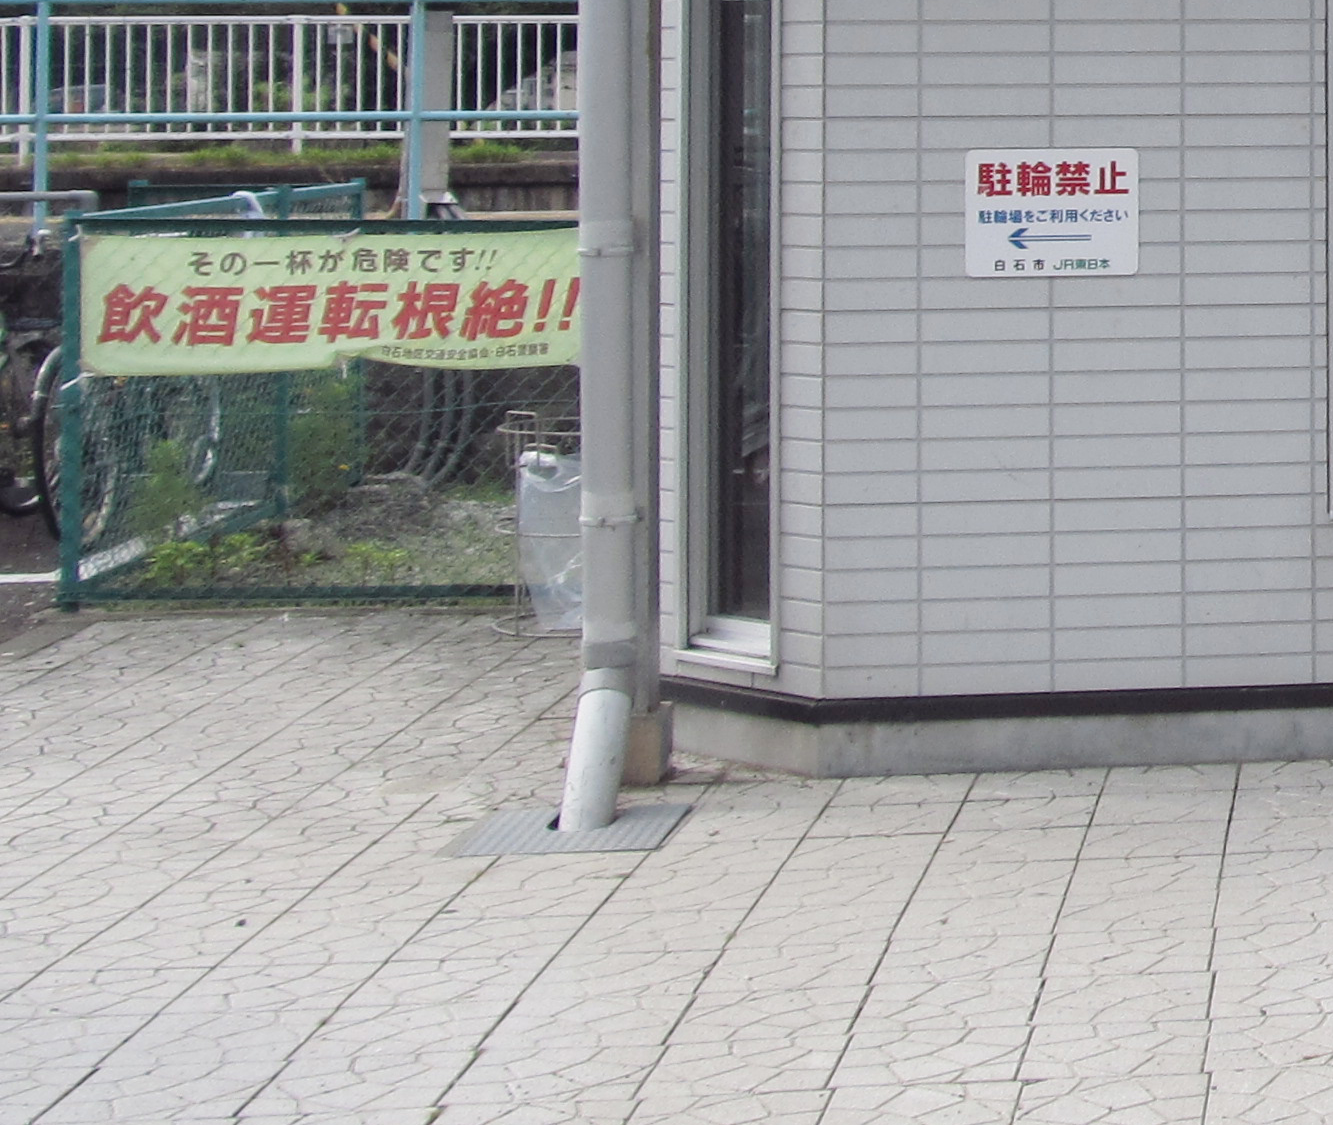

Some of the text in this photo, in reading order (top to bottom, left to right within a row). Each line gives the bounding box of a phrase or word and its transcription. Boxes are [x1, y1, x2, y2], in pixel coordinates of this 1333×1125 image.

[977, 160, 1129, 197] 駐輪禁止
[978, 210, 1129, 224] 駐輪場をご利用ください
[994, 258, 1111, 272] 白石市 JR東日本
[96, 277, 580, 347] 飲酒運転根絶!!
